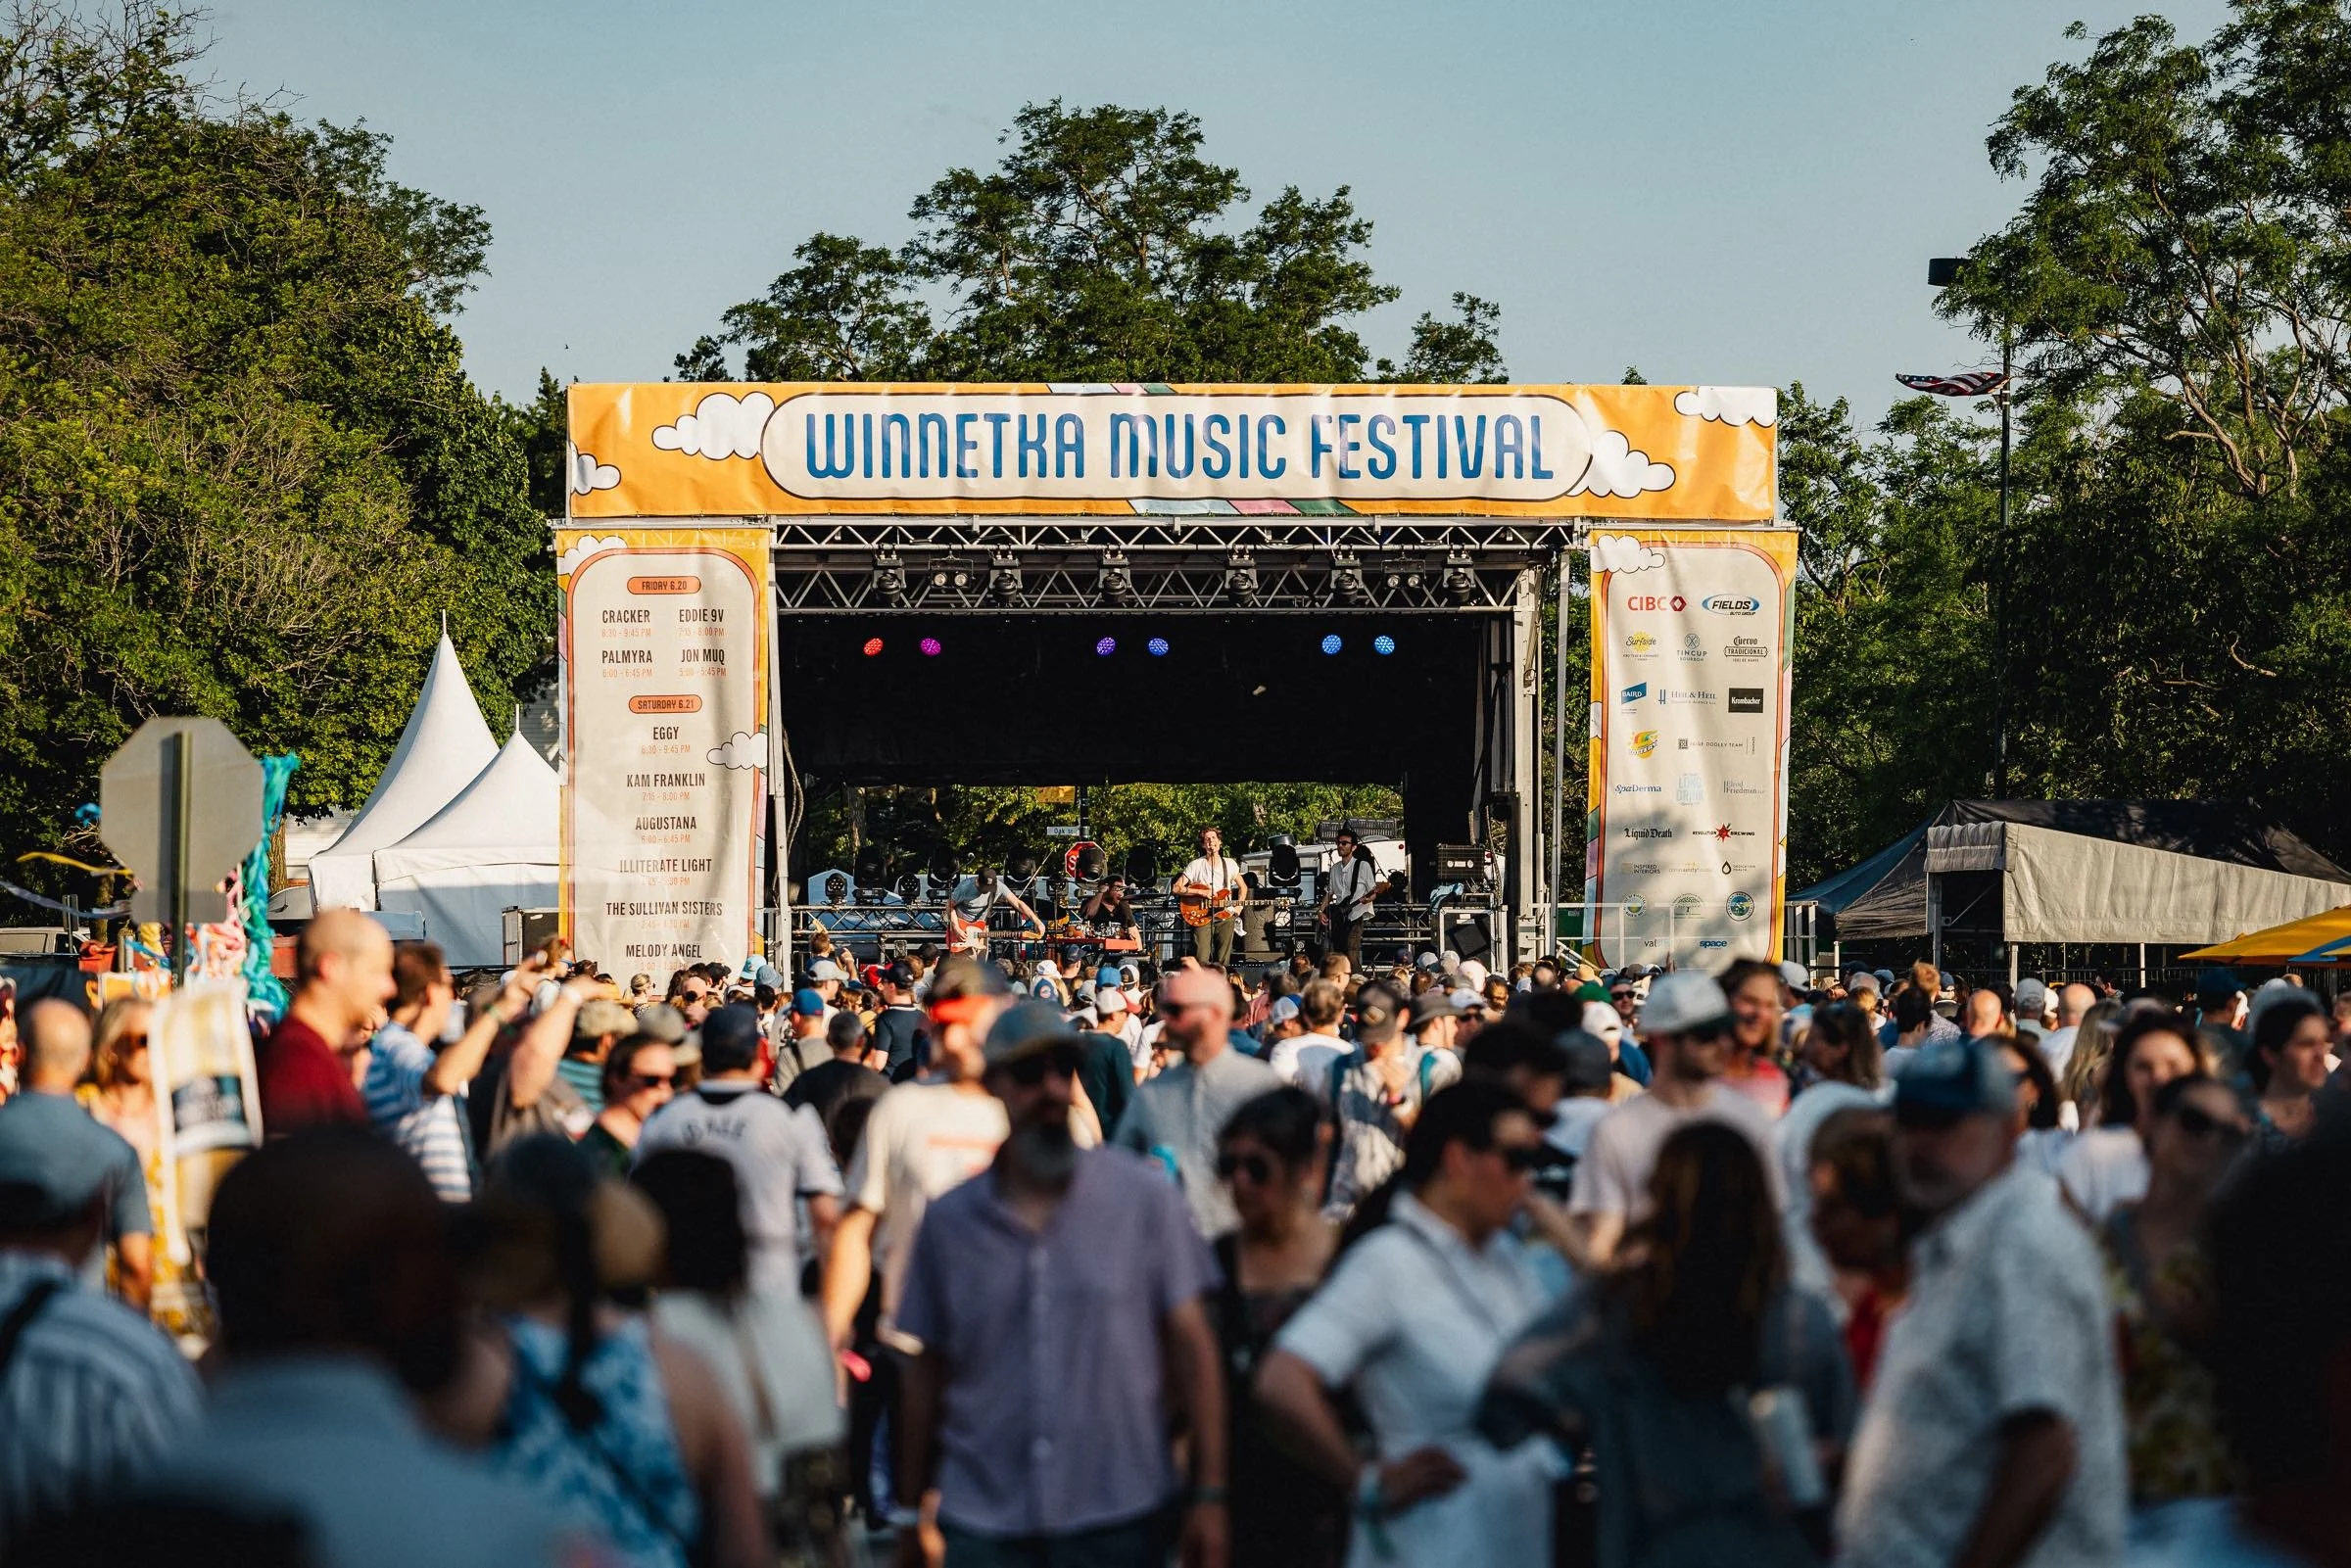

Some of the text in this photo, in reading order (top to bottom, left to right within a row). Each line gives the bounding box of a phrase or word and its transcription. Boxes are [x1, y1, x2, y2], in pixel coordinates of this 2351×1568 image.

[806, 412, 1554, 480] WINNETKA MUSIC FESTIVAL
[642, 580, 688, 591] FRIDAY 6.20
[1627, 595, 1667, 611] CIBC
[1711, 600, 1751, 610] FIELDS
[601, 609, 650, 624] CRACKER
[679, 608, 725, 623] EDDIE 9V
[624, 628, 639, 638] 9:45
[641, 628, 651, 638] PM
[714, 627, 725, 637] PM
[1625, 636, 1656, 646] Surfside
[1733, 636, 1758, 646] Cuervo
[601, 649, 653, 664] PALMYRA
[681, 648, 725, 665] JON MUQ
[641, 668, 652, 678] PM
[716, 667, 727, 677] PM
[638, 699, 695, 710] SATURDAY 6.21
[1731, 696, 1761, 705] Krombacher
[652, 726, 680, 740] EGGY
[663, 744, 679, 754] 9:45
[680, 744, 691, 754] PM
[626, 773, 705, 787] KAM FRANKLIN
[1614, 784, 1662, 794] SpaDerma
[679, 791, 691, 800] PM
[635, 816, 697, 831] AUGUSTANA
[680, 834, 691, 843] PM
[1624, 828, 1673, 840] Liquid Death
[619, 858, 713, 874] ILLITERATE LIGHT
[680, 877, 691, 885] PM
[605, 901, 723, 916] THE SULLIVAN SISTERS
[1699, 939, 1728, 949] space
[626, 944, 702, 958] MELODY ANGEL
